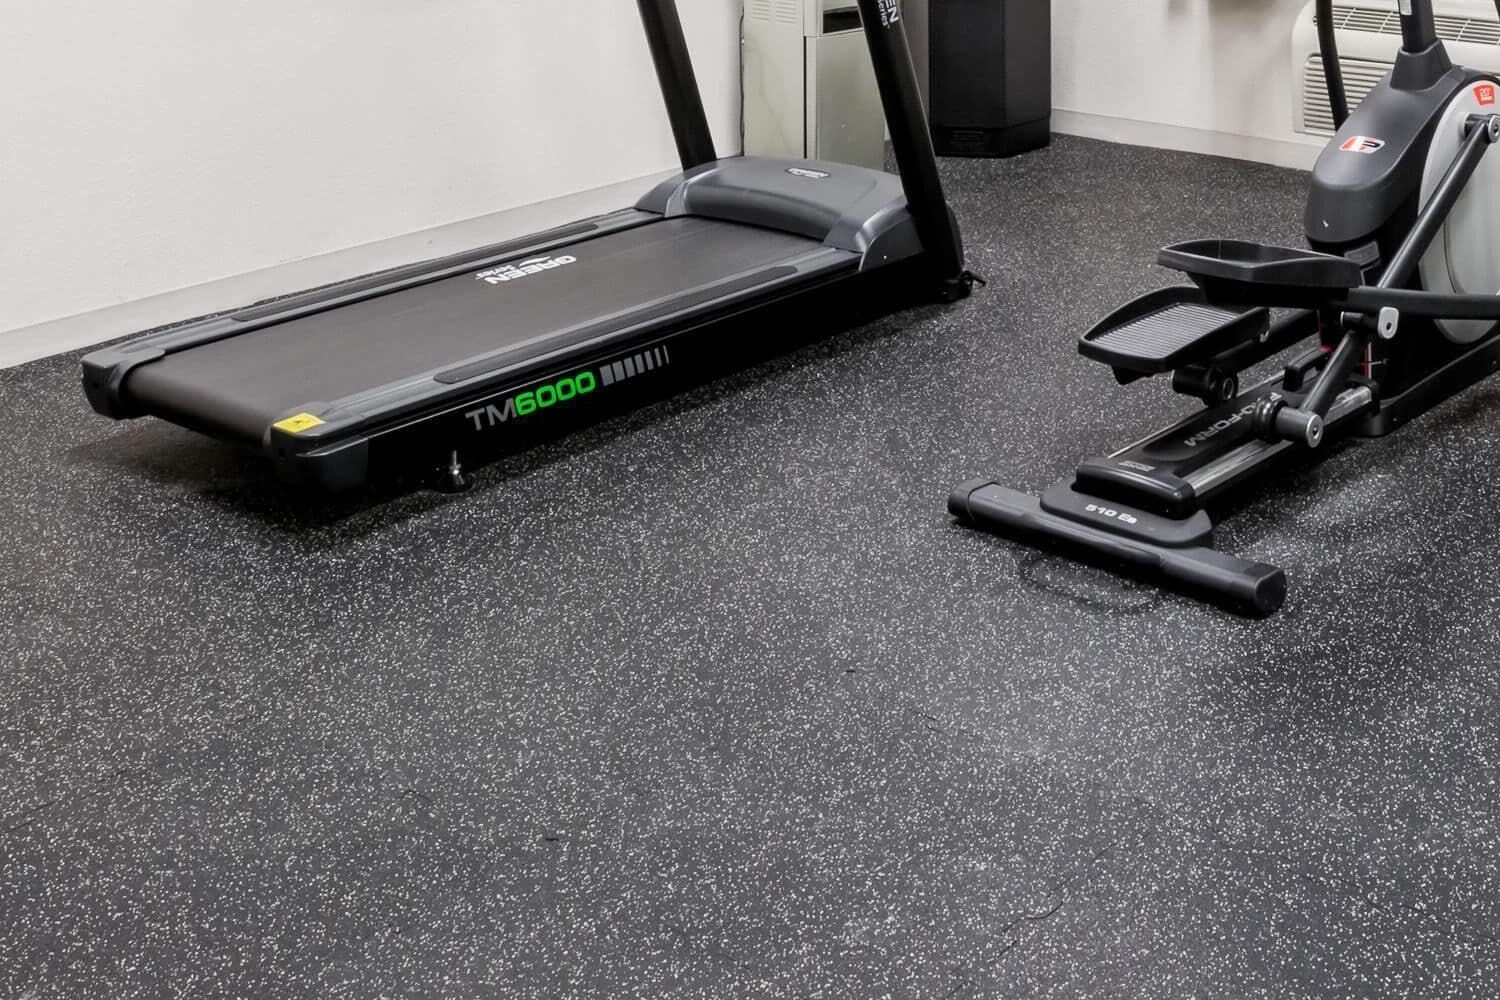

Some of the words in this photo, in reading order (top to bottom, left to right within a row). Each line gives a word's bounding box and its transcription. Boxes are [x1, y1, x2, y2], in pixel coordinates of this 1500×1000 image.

[484, 256, 577, 284] GREEN
[465, 371, 596, 431] TM6000
[1184, 392, 1283, 447] PO-FORM
